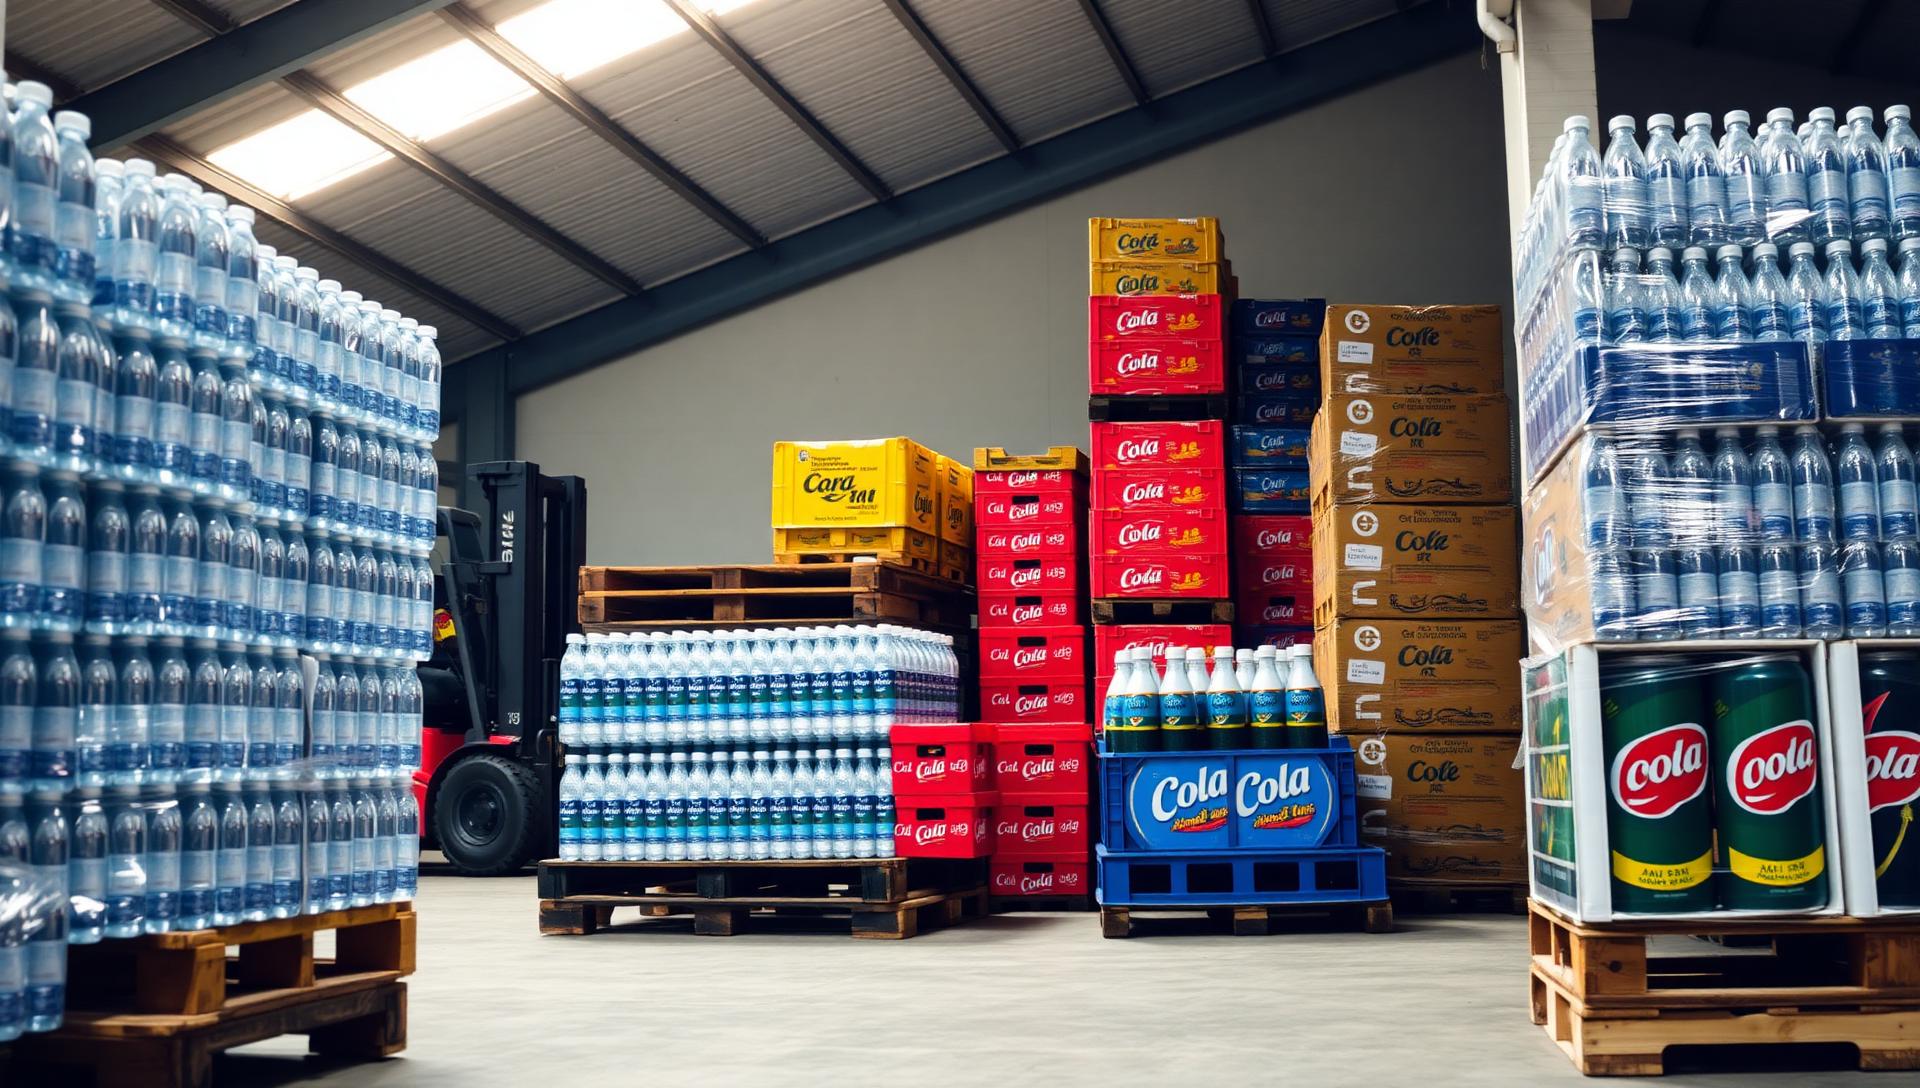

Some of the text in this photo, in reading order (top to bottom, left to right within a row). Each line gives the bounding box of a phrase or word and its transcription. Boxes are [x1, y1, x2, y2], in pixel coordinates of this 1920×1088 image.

[1117, 310, 1158, 332] Cola
[1117, 353, 1158, 374] Cola
[1389, 417, 1442, 437] Cola
[1117, 439, 1159, 460] Cola
[1122, 484, 1164, 503] Cola
[1119, 524, 1161, 545] Cola
[1395, 530, 1450, 551] Cola
[1398, 645, 1454, 667] Cola
[1626, 735, 1703, 791] cola
[1866, 746, 1920, 782] ola
[1152, 766, 1228, 822] Cola
[1236, 763, 1311, 818] Cola
